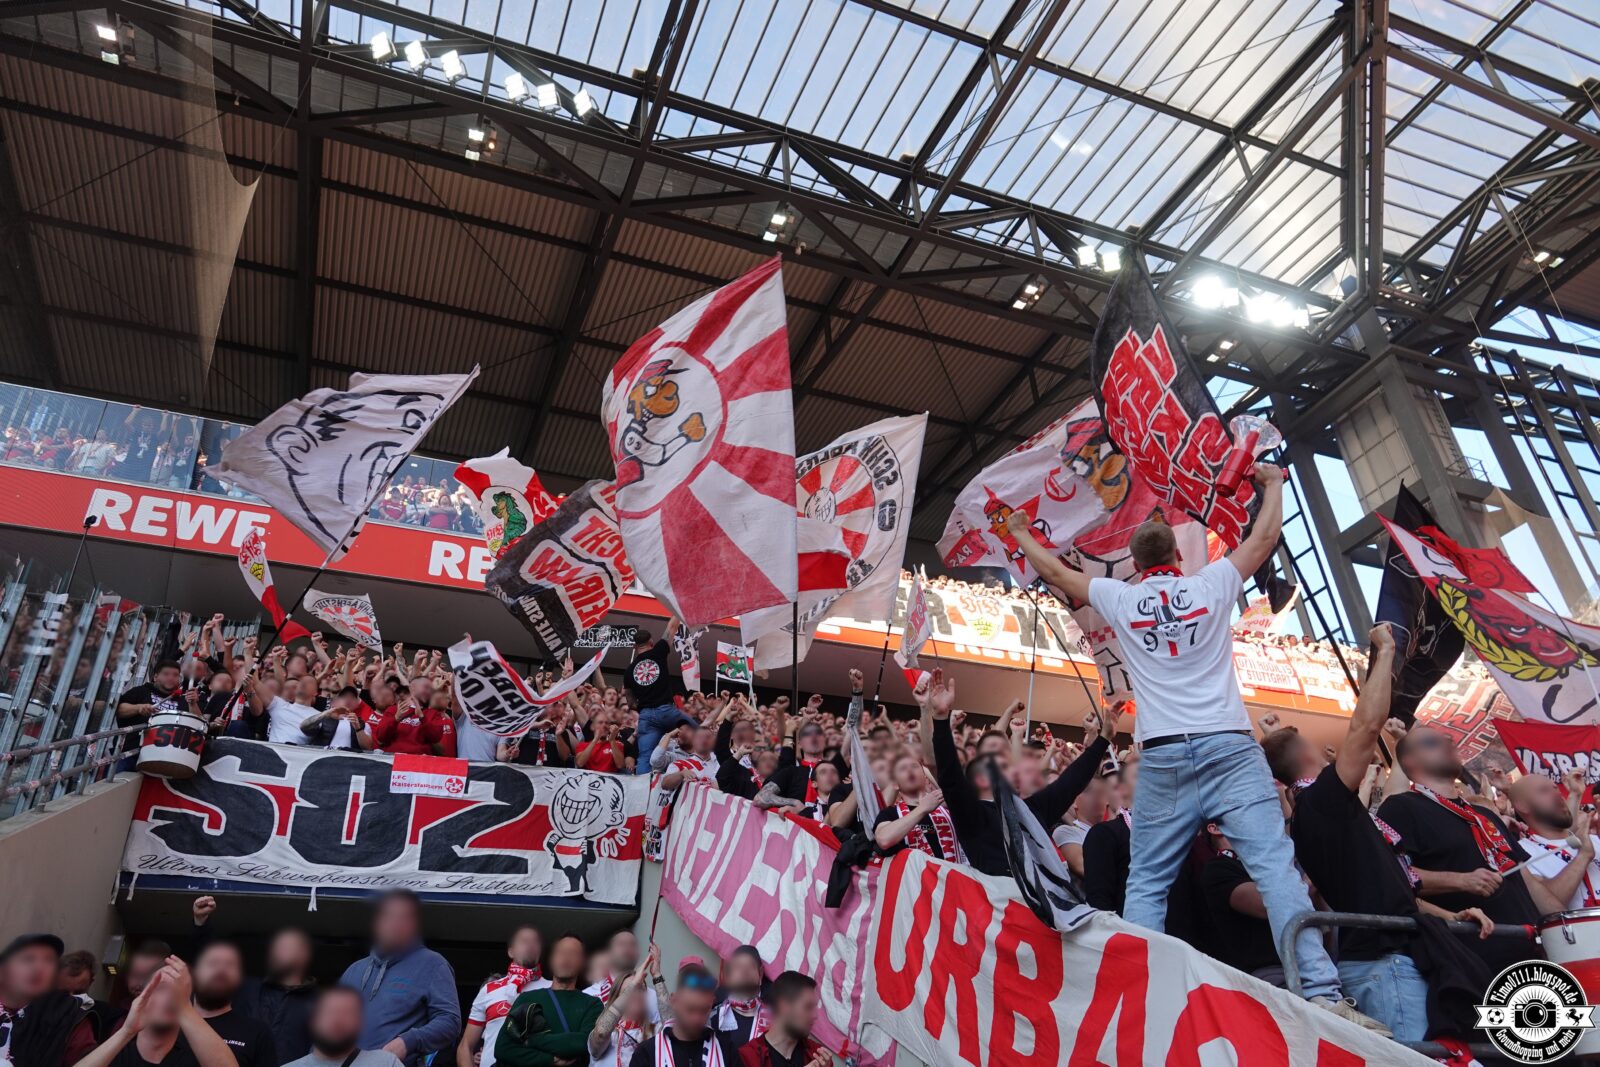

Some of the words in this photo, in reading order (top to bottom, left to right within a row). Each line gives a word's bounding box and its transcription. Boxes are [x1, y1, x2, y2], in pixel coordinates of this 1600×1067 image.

[85, 488, 271, 550] REWE
[391, 781, 443, 790] Kaiserslautern
[138, 853, 221, 876] Ultras
[231, 861, 430, 890] Schwabensturm
[434, 872, 554, 896] Stuttgart
